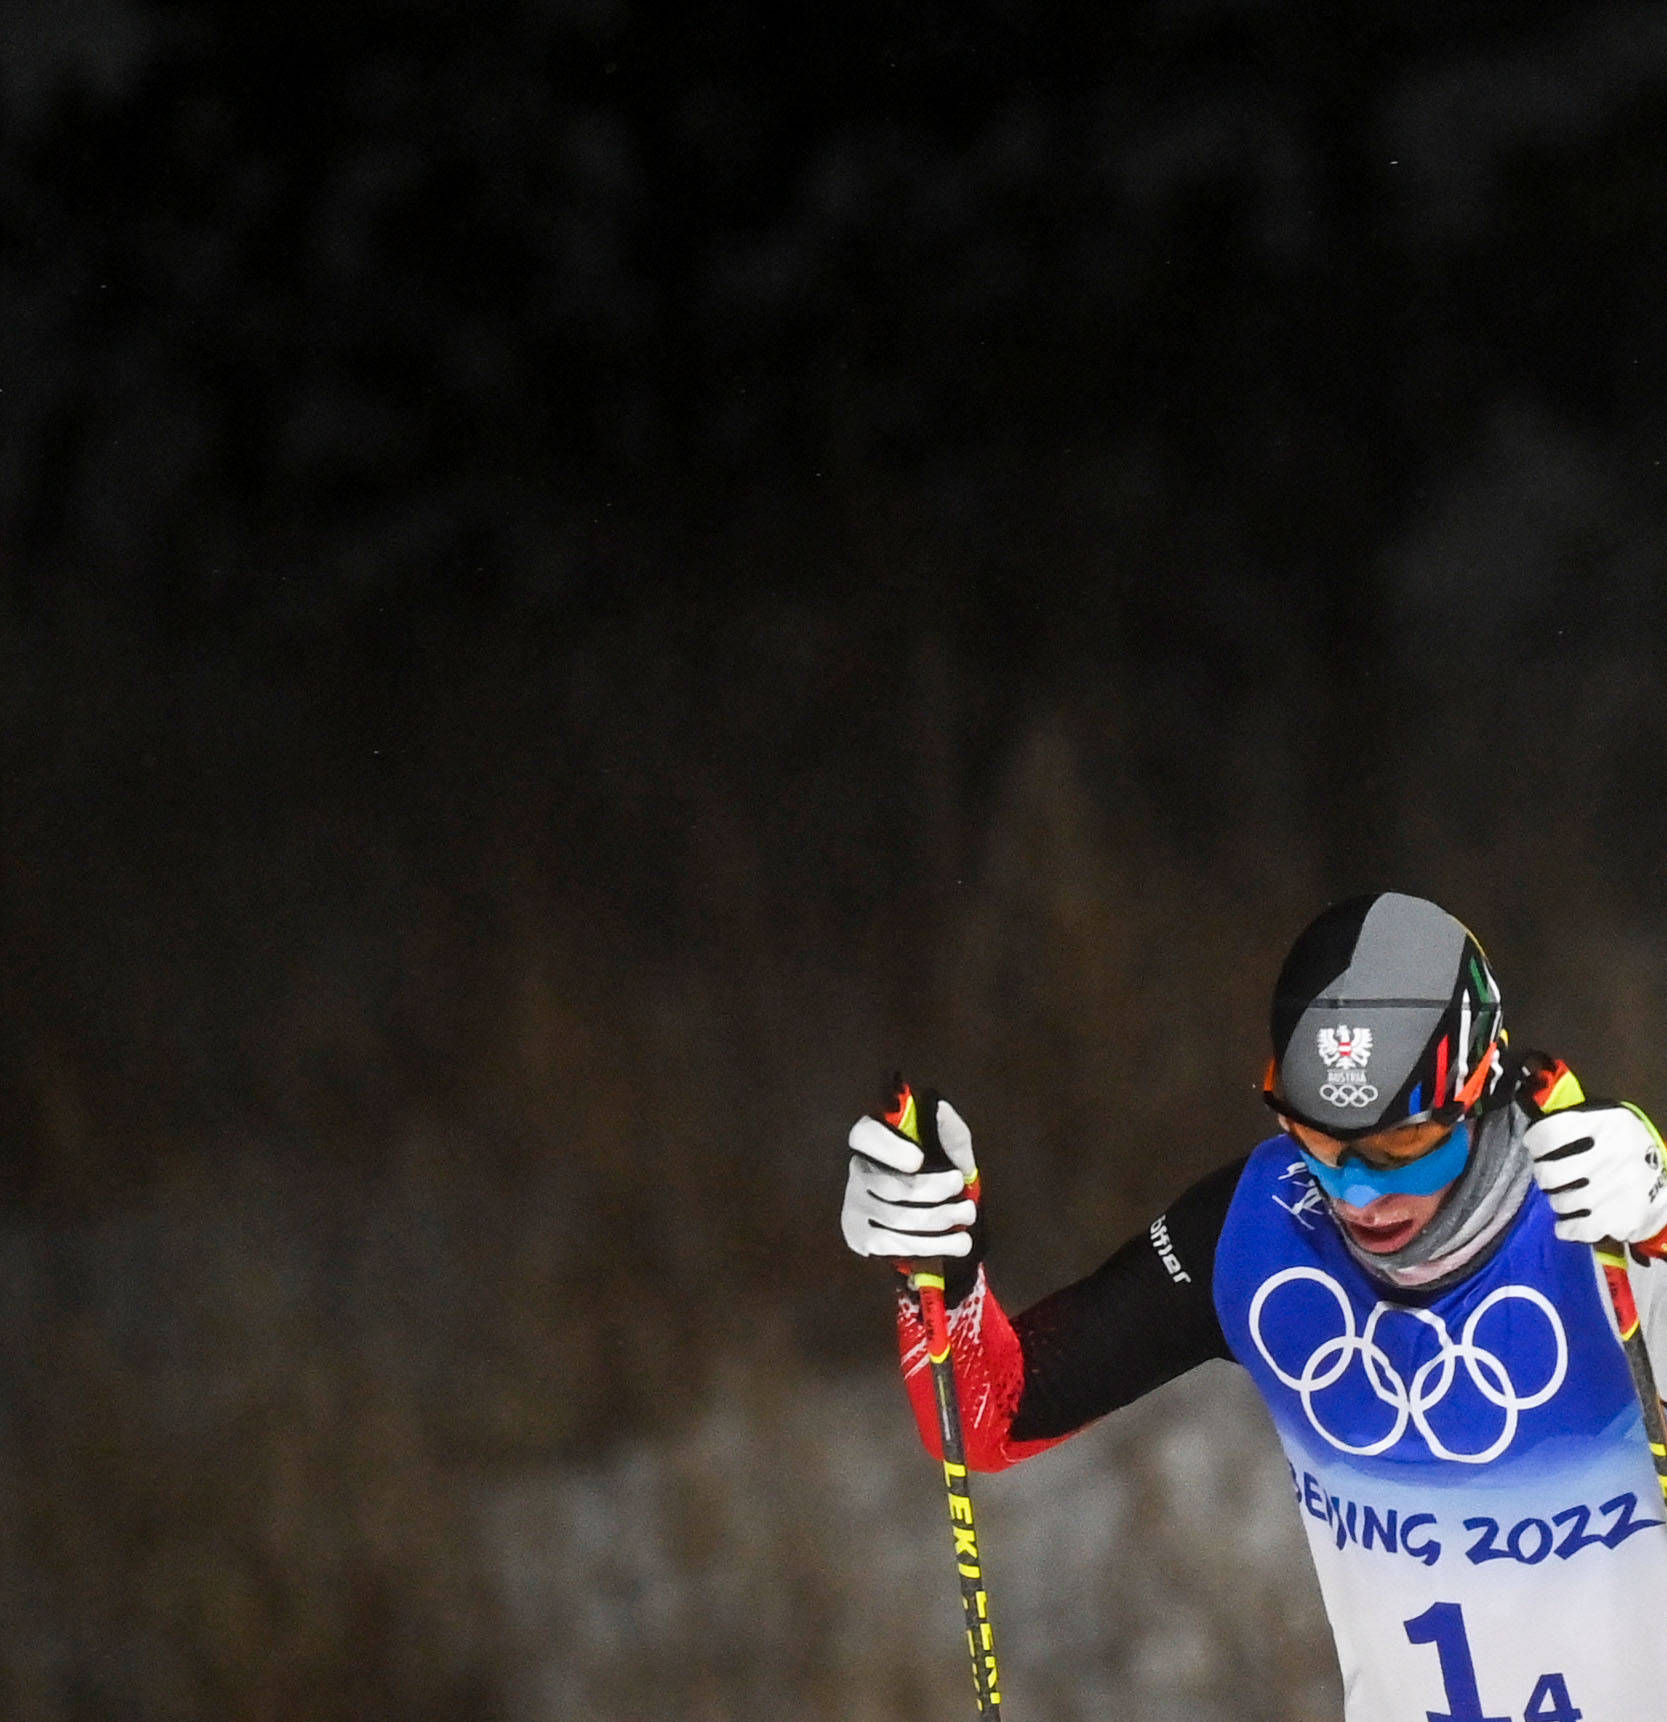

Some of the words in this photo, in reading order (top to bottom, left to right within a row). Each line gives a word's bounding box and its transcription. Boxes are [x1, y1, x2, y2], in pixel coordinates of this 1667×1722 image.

[944, 1459, 981, 1578] LEKI
[1291, 1462, 1441, 1567] EIJING
[1462, 1492, 1667, 1566] 2022
